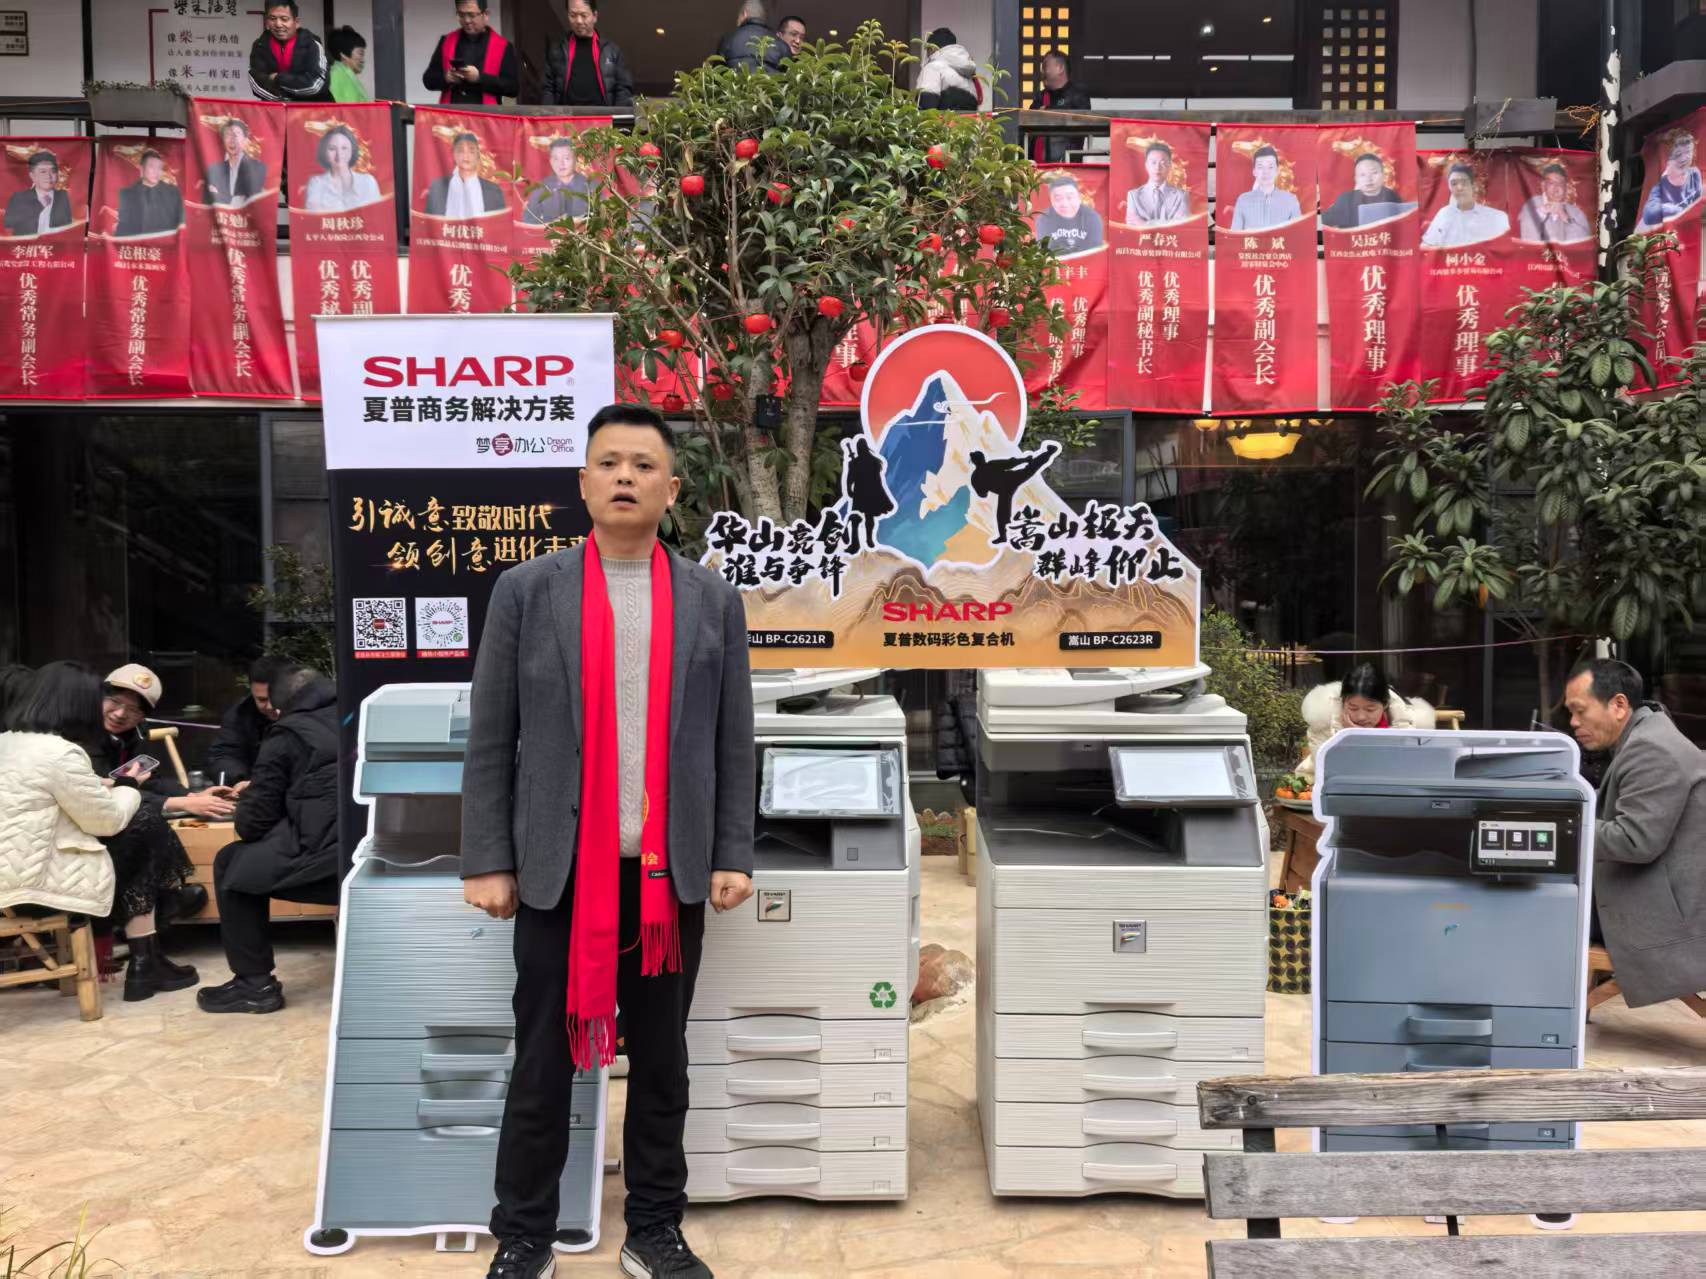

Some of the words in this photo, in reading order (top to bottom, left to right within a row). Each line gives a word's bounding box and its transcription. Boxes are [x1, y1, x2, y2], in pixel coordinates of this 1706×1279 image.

[321, 216, 365, 231] 周秋珍
[1138, 232, 1179, 248] 严春兴
[448, 264, 473, 313] 优秀
[1162, 271, 1180, 341] 优秀理事
[20, 272, 38, 386] 优秀常务副会长
[127, 275, 149, 387] 优秀常务副会长
[227, 247, 253, 377] 优秀常务副会长
[1071, 296, 1089, 358] 优秀理事
[1137, 271, 1154, 375] 优秀副秘书长
[1253, 274, 1277, 385] 优秀副会长
[1360, 265, 1387, 372] 优秀理事
[1455, 284, 1480, 377] 优秀理事
[363, 355, 574, 388] SHARP
[363, 395, 575, 422] 夏普商务解决方案
[476, 433, 545, 456] 梦享办公
[547, 437, 573, 446] Dream
[550, 444, 575, 453] Office
[349, 496, 552, 533] 引诚意致敬时代
[723, 554, 847, 597] 谁与争锋
[1036, 545, 1183, 585] 群峰仰止
[882, 601, 1013, 621] SHARP
[766, 634, 826, 644] BP-C2621R
[884, 632, 1015, 646] 夏普数码彩色复合机
[1068, 635, 1090, 646] 嵩山
[1093, 634, 1153, 645] BP-C2623R
